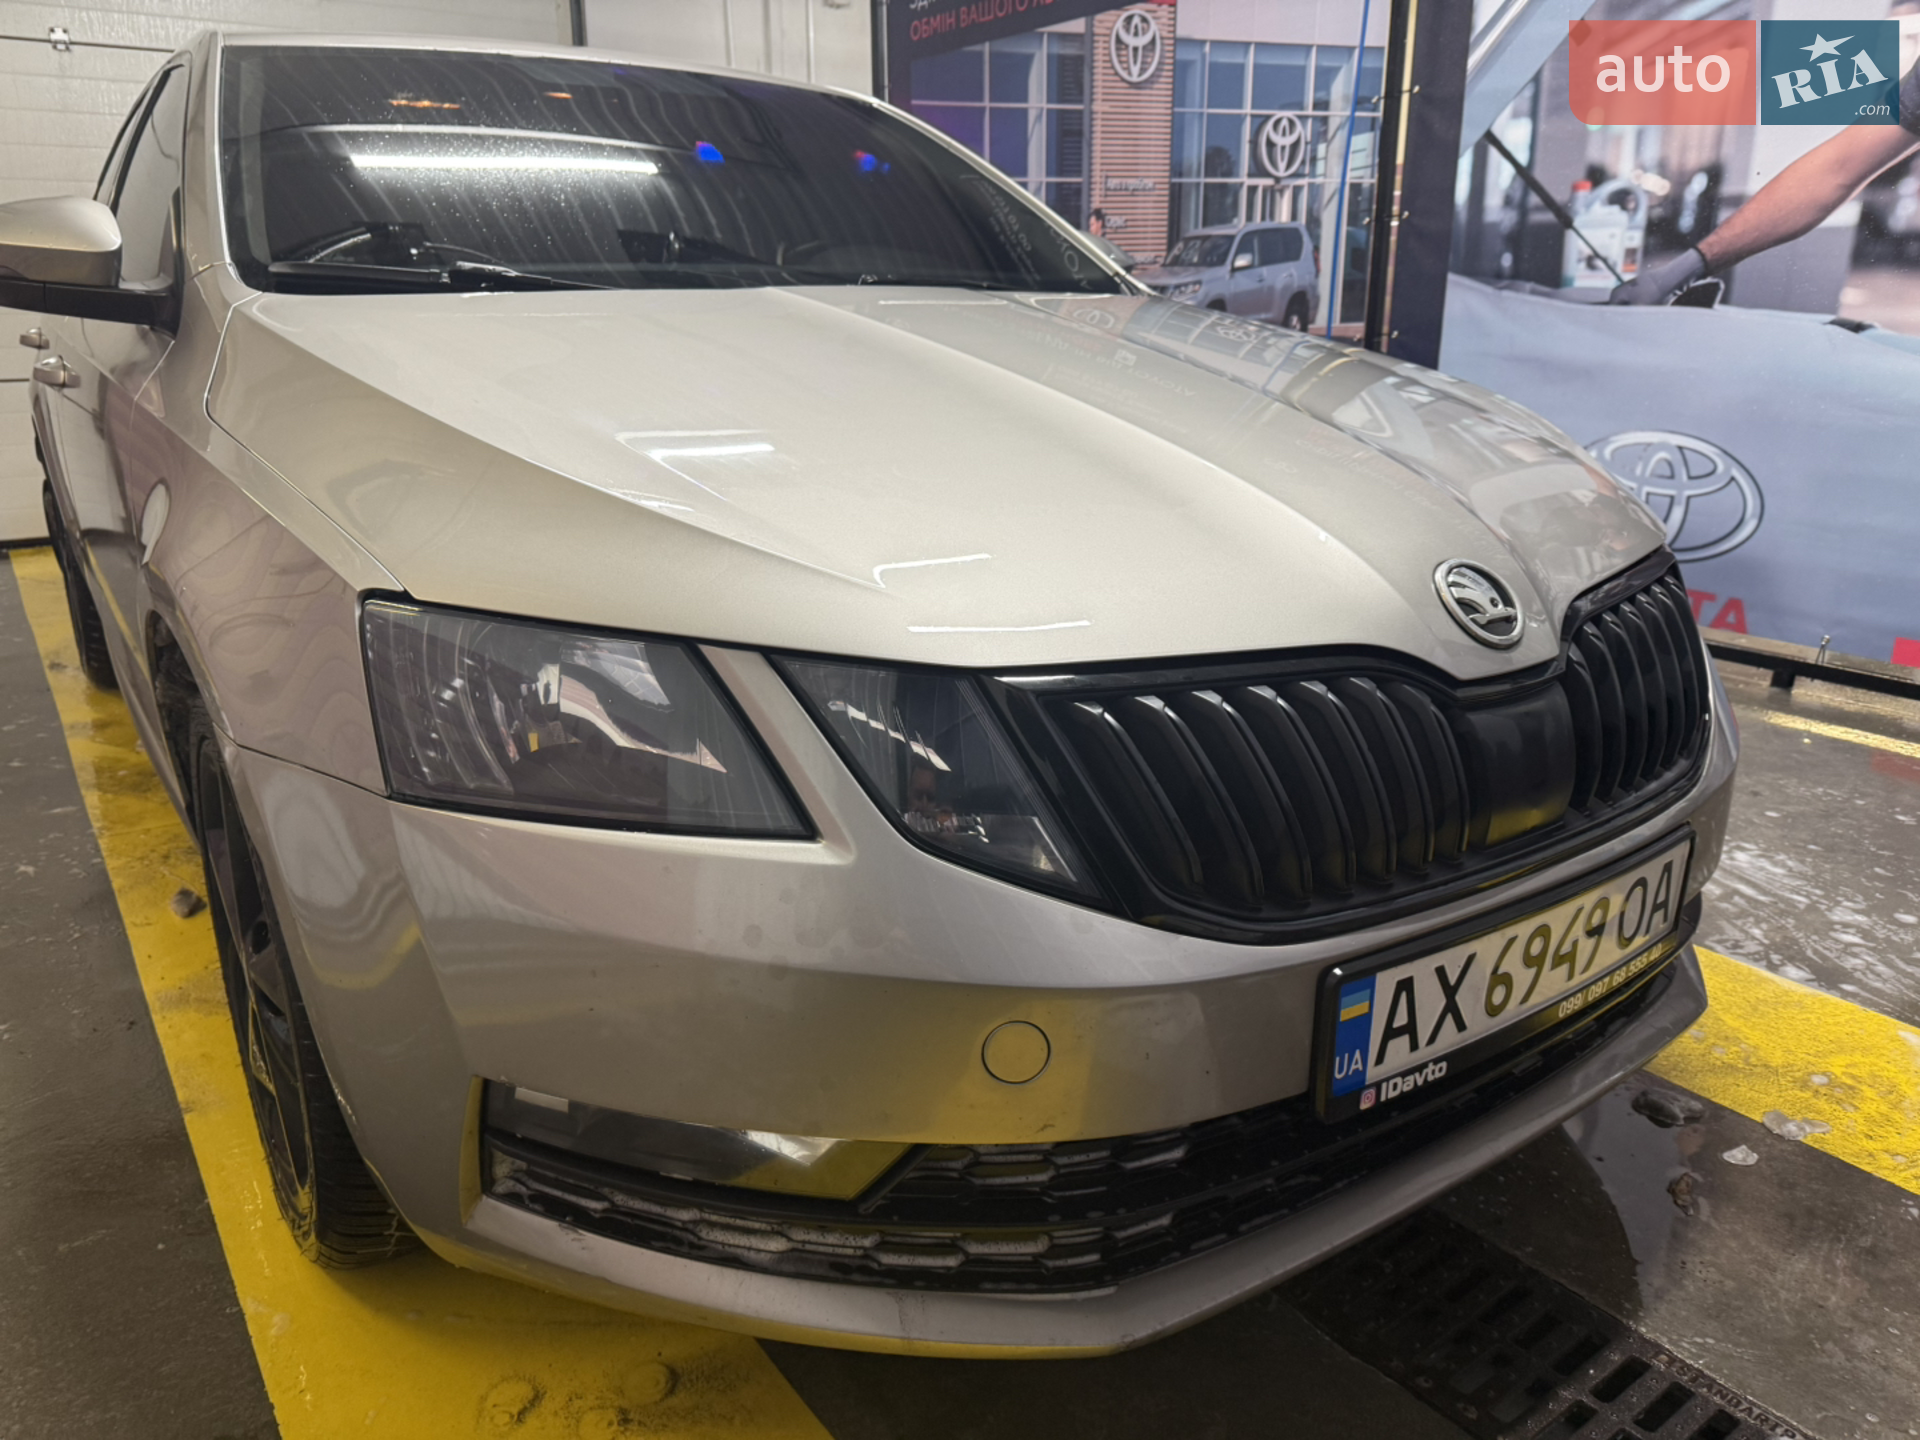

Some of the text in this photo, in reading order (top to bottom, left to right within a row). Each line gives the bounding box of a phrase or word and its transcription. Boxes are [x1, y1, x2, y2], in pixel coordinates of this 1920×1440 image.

[910, 13, 956, 41] ОБМІН
[1373, 859, 1674, 1068] AX 6949 OA
[1334, 1049, 1363, 1079] UA
[1380, 1061, 1448, 1102] IDavto
